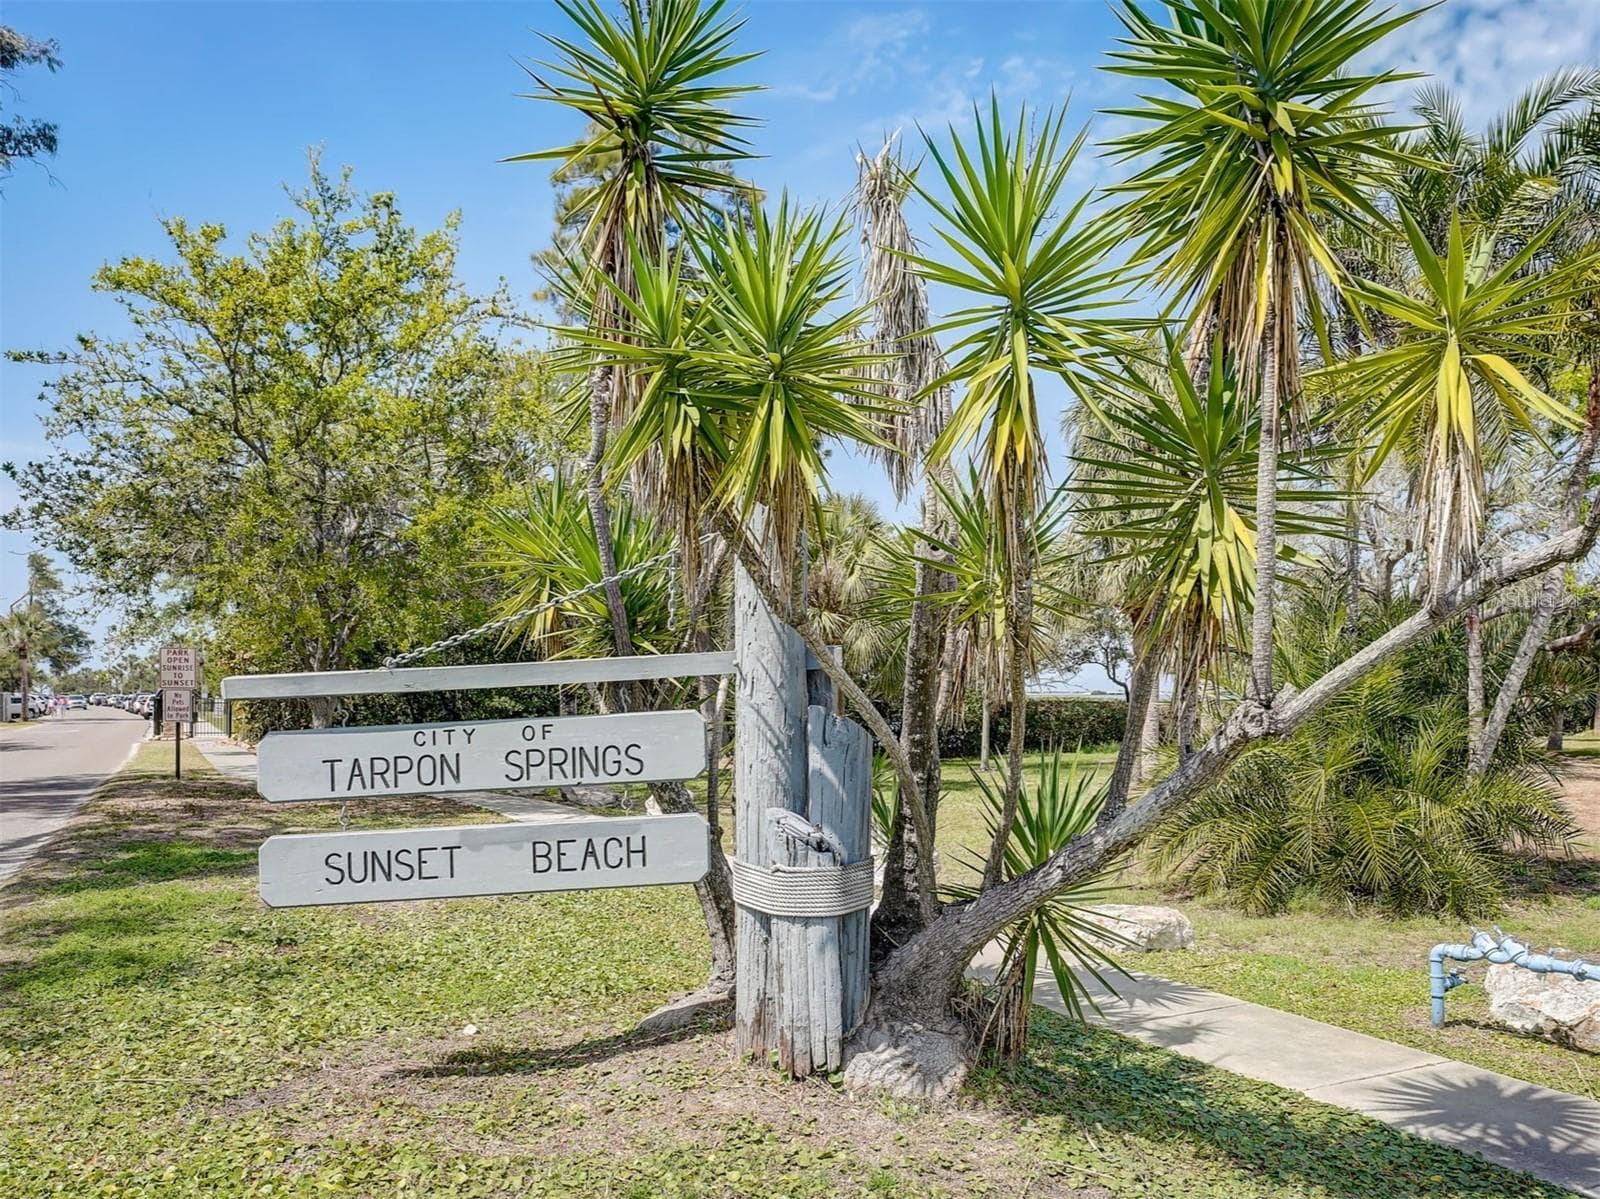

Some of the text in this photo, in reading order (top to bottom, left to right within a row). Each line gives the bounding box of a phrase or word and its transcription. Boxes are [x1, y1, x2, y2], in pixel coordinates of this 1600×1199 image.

[413, 724, 554, 747] CITY OF
[322, 743, 644, 792] TARPON SPRINGS
[324, 835, 647, 885] SUNSET BEACH
